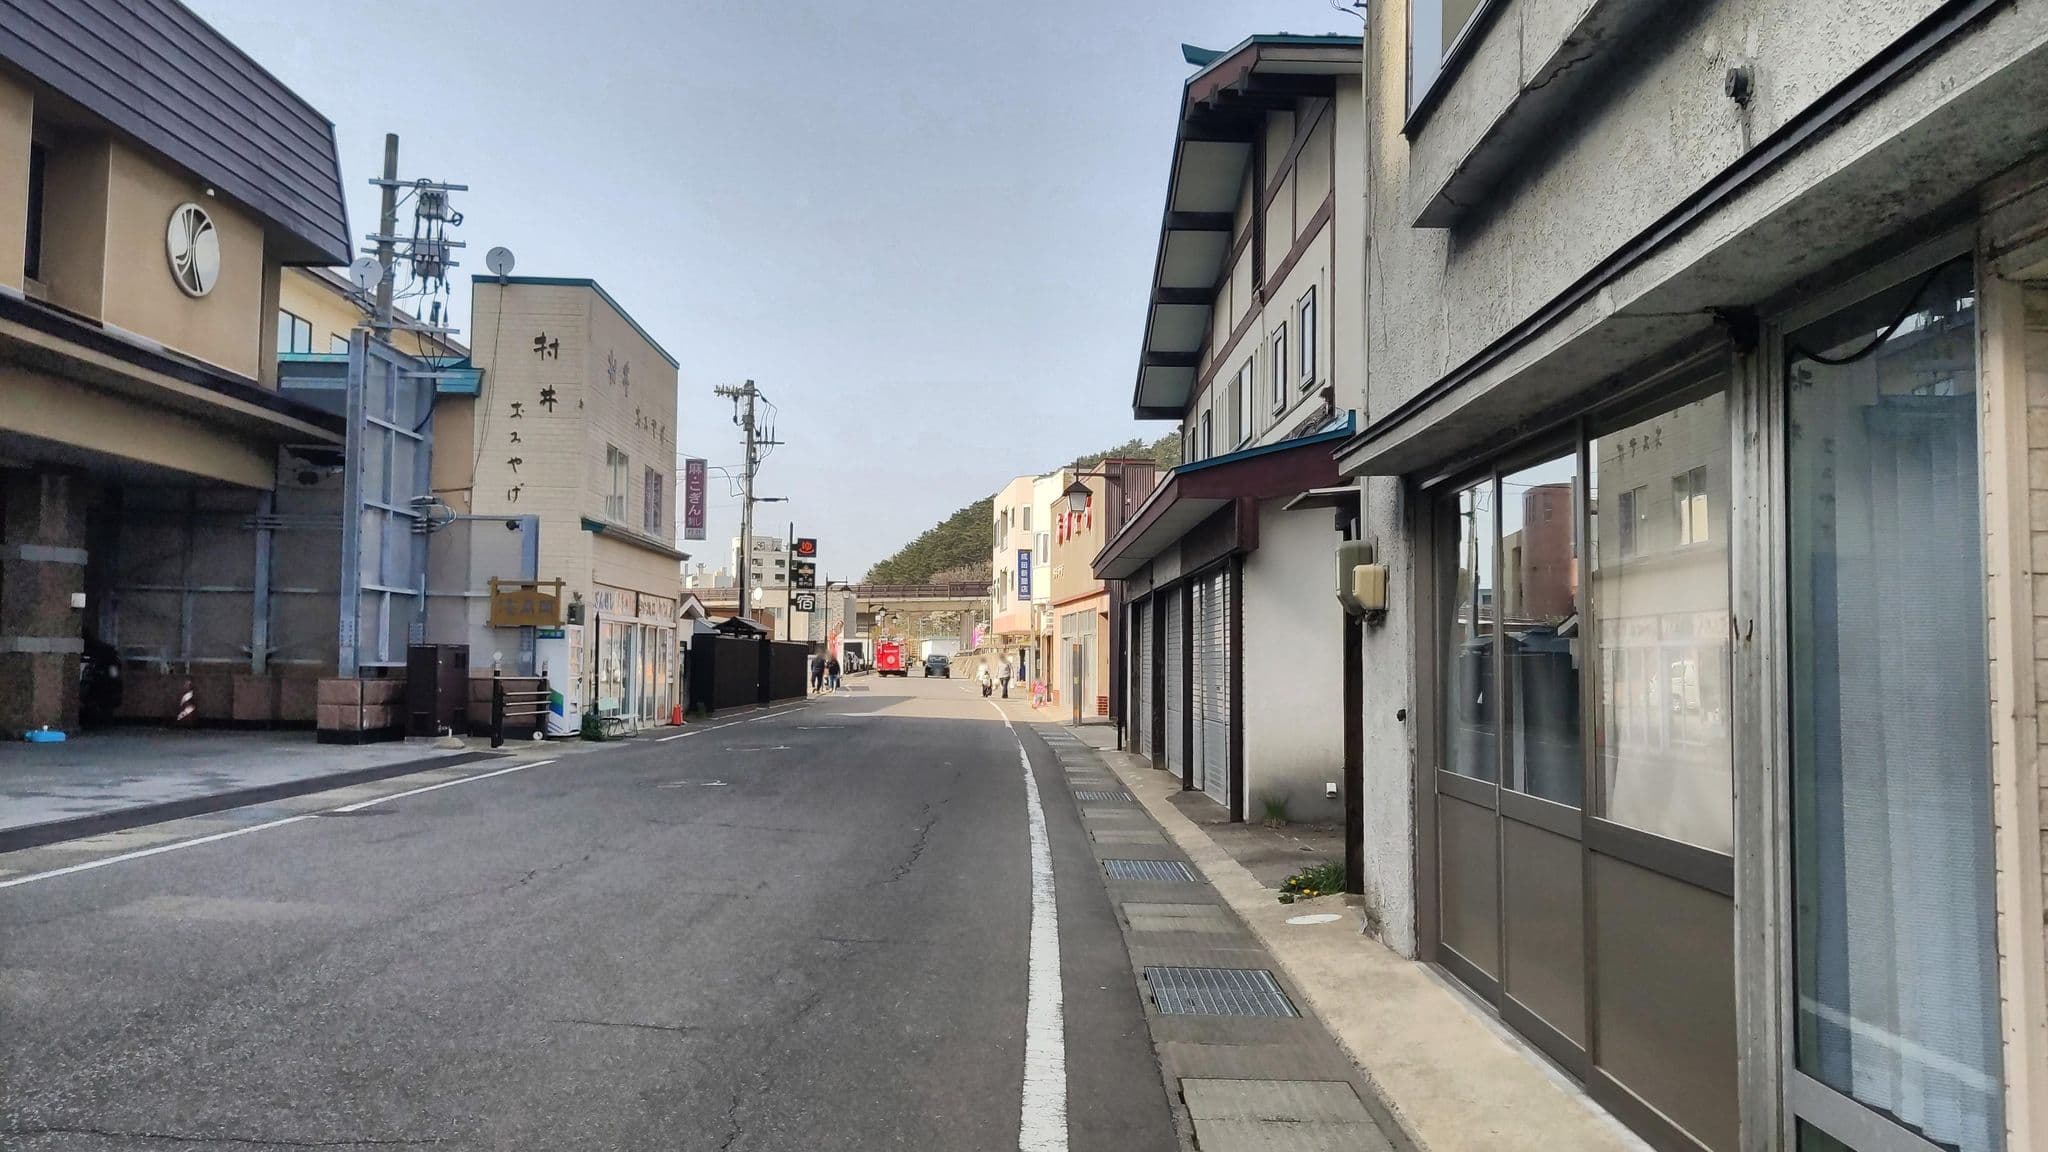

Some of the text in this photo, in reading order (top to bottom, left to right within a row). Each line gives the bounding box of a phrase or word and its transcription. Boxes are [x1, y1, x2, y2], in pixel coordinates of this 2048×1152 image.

[507, 401, 525, 503] おみやげ
[797, 594, 814, 610] 宿
